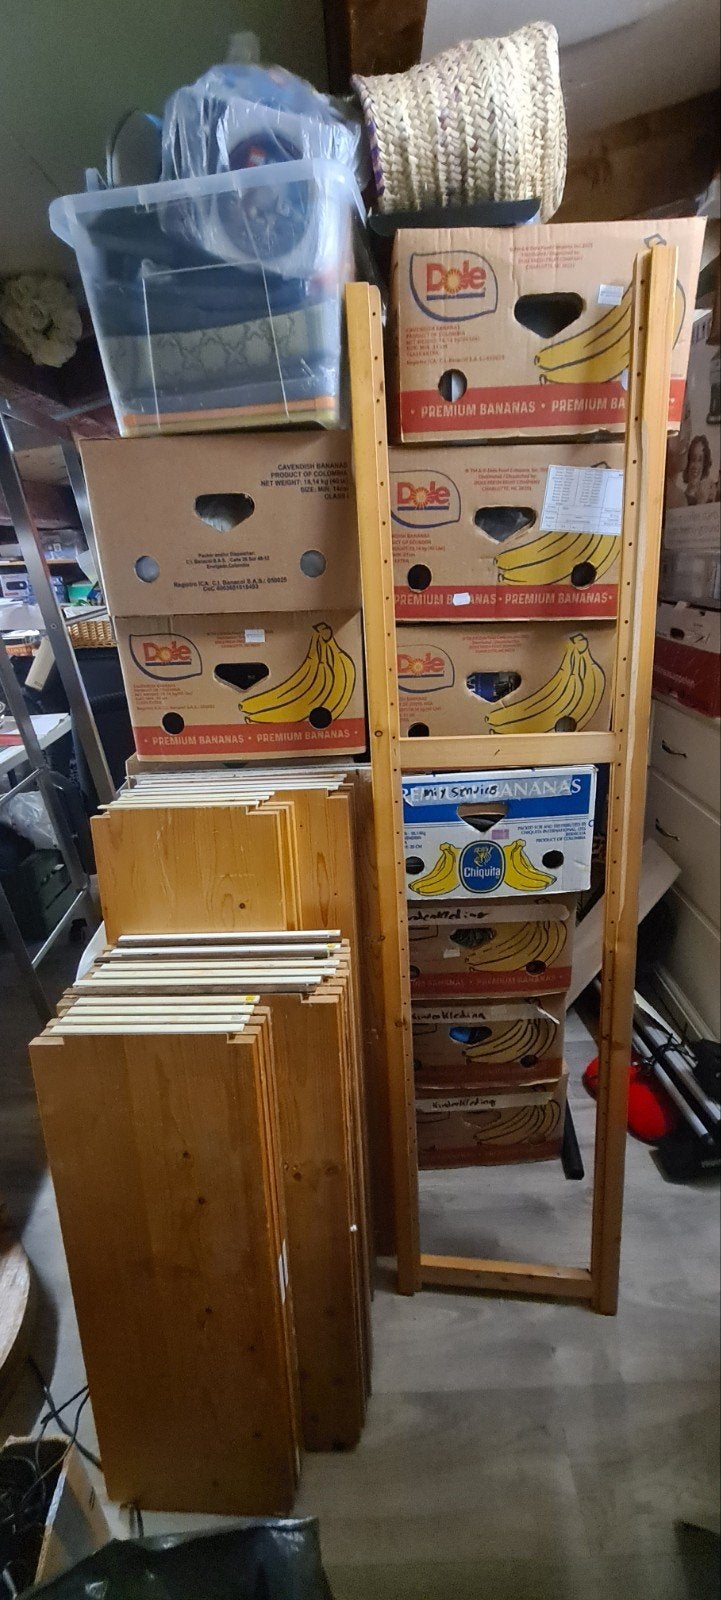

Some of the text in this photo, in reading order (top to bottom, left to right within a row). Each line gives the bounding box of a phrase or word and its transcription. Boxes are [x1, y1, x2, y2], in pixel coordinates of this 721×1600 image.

[426, 260, 486, 293] Dole
[421, 403, 476, 418] PREMIUM
[480, 401, 535, 416] BANANAS
[552, 398, 609, 412] PREMIUM
[397, 481, 450, 508] Dole
[395, 592, 608, 605] PREMIUM BANAS PREMIUM BANANAS
[142, 640, 191, 662] Dole
[397, 653, 444, 675] Dole
[152, 729, 350, 746] PREMIUM BANANAS PREMIUM BANANAS
[489, 778, 581, 800] BANANAS
[464, 866, 500, 879] Chiquita
